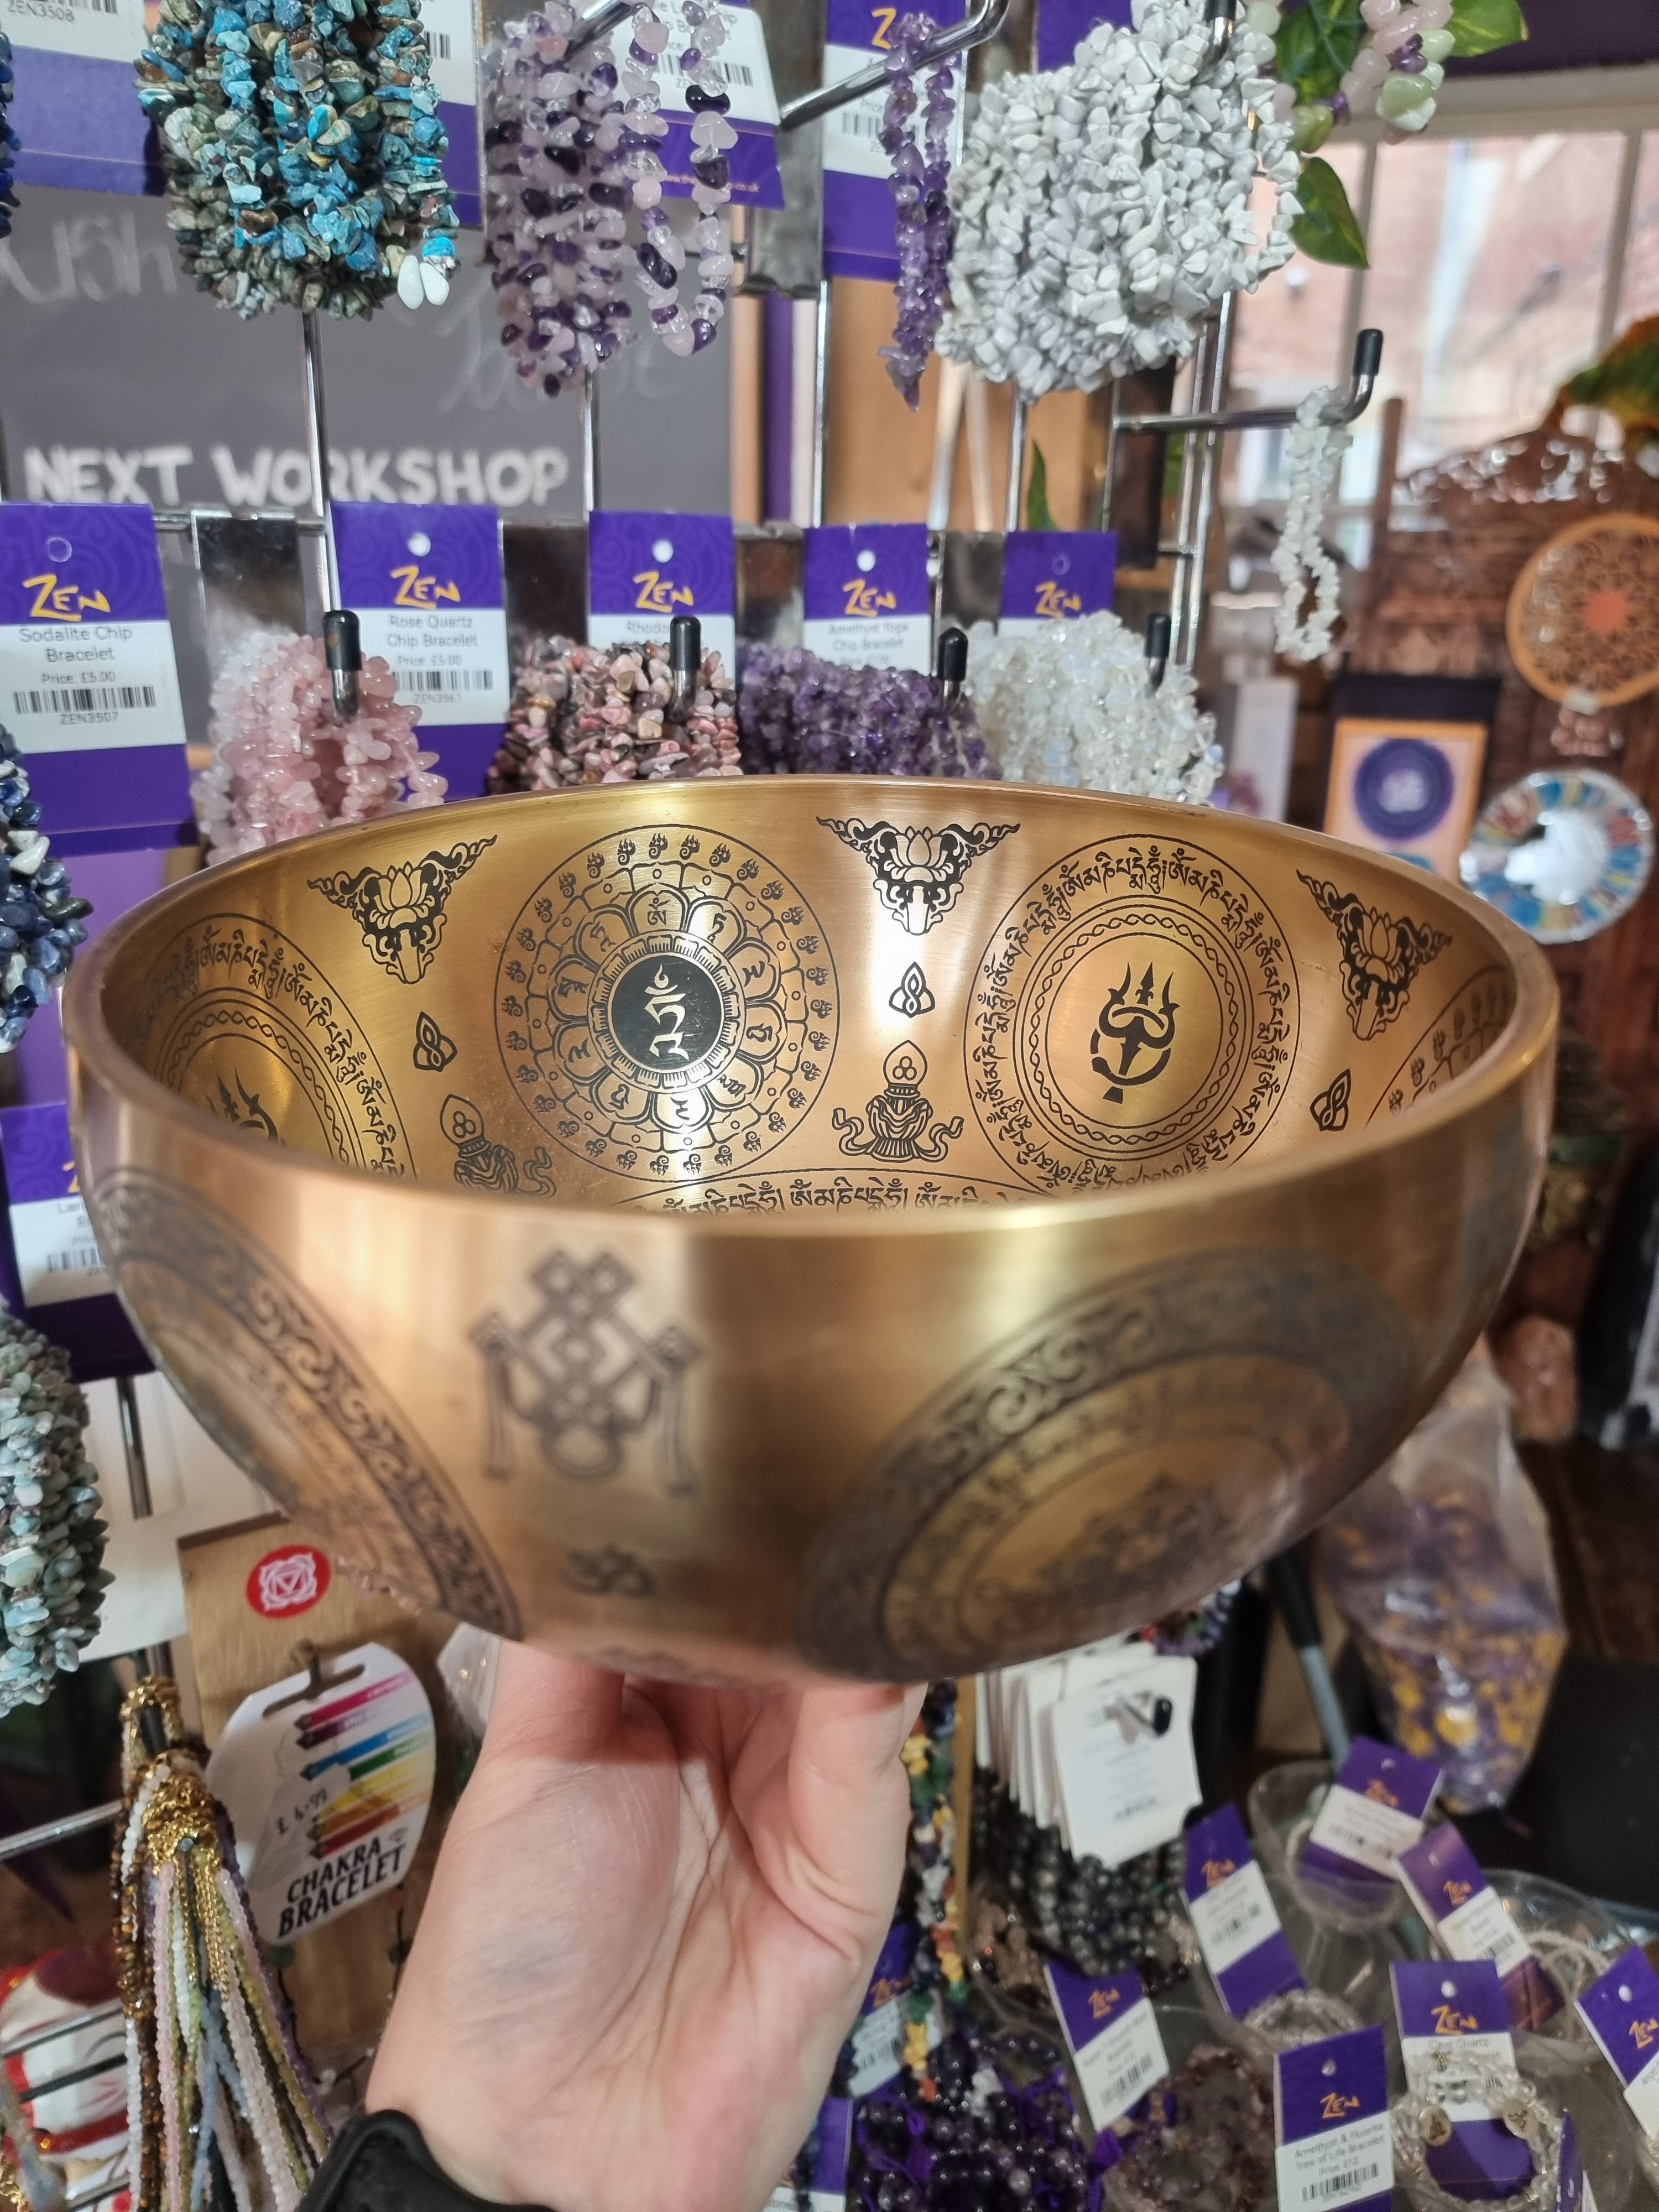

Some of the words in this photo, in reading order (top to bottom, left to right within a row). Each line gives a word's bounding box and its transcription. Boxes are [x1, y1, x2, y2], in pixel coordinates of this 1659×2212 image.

[23, 446, 194, 506] NEXT
[209, 446, 569, 508] WORKSHOP
[22, 573, 111, 622] ZEN
[390, 565, 461, 611] ZEN
[633, 570, 694, 613] ZEN
[842, 579, 897, 617] ZEN
[1035, 582, 1082, 619] ZEN
[20, 627, 90, 642] Sodalite
[95, 625, 133, 643] Chip
[390, 615, 423, 628] Rose
[427, 615, 473, 630] Quartz
[45, 647, 115, 662] Bracelet
[387, 634, 419, 650] Chip
[424, 633, 477, 647] Bracelet
[81, 671, 116, 684] £5.00
[288, 1837, 382, 1904] CHAKRA
[279, 1843, 406, 1938] BRACELET
[1431, 2004, 1479, 2036] ZEN
[1319, 2092, 1360, 2119] ZEN
[1294, 2138, 1339, 2159] Amethyst
[1347, 2135, 1385, 2153] Bracelet
